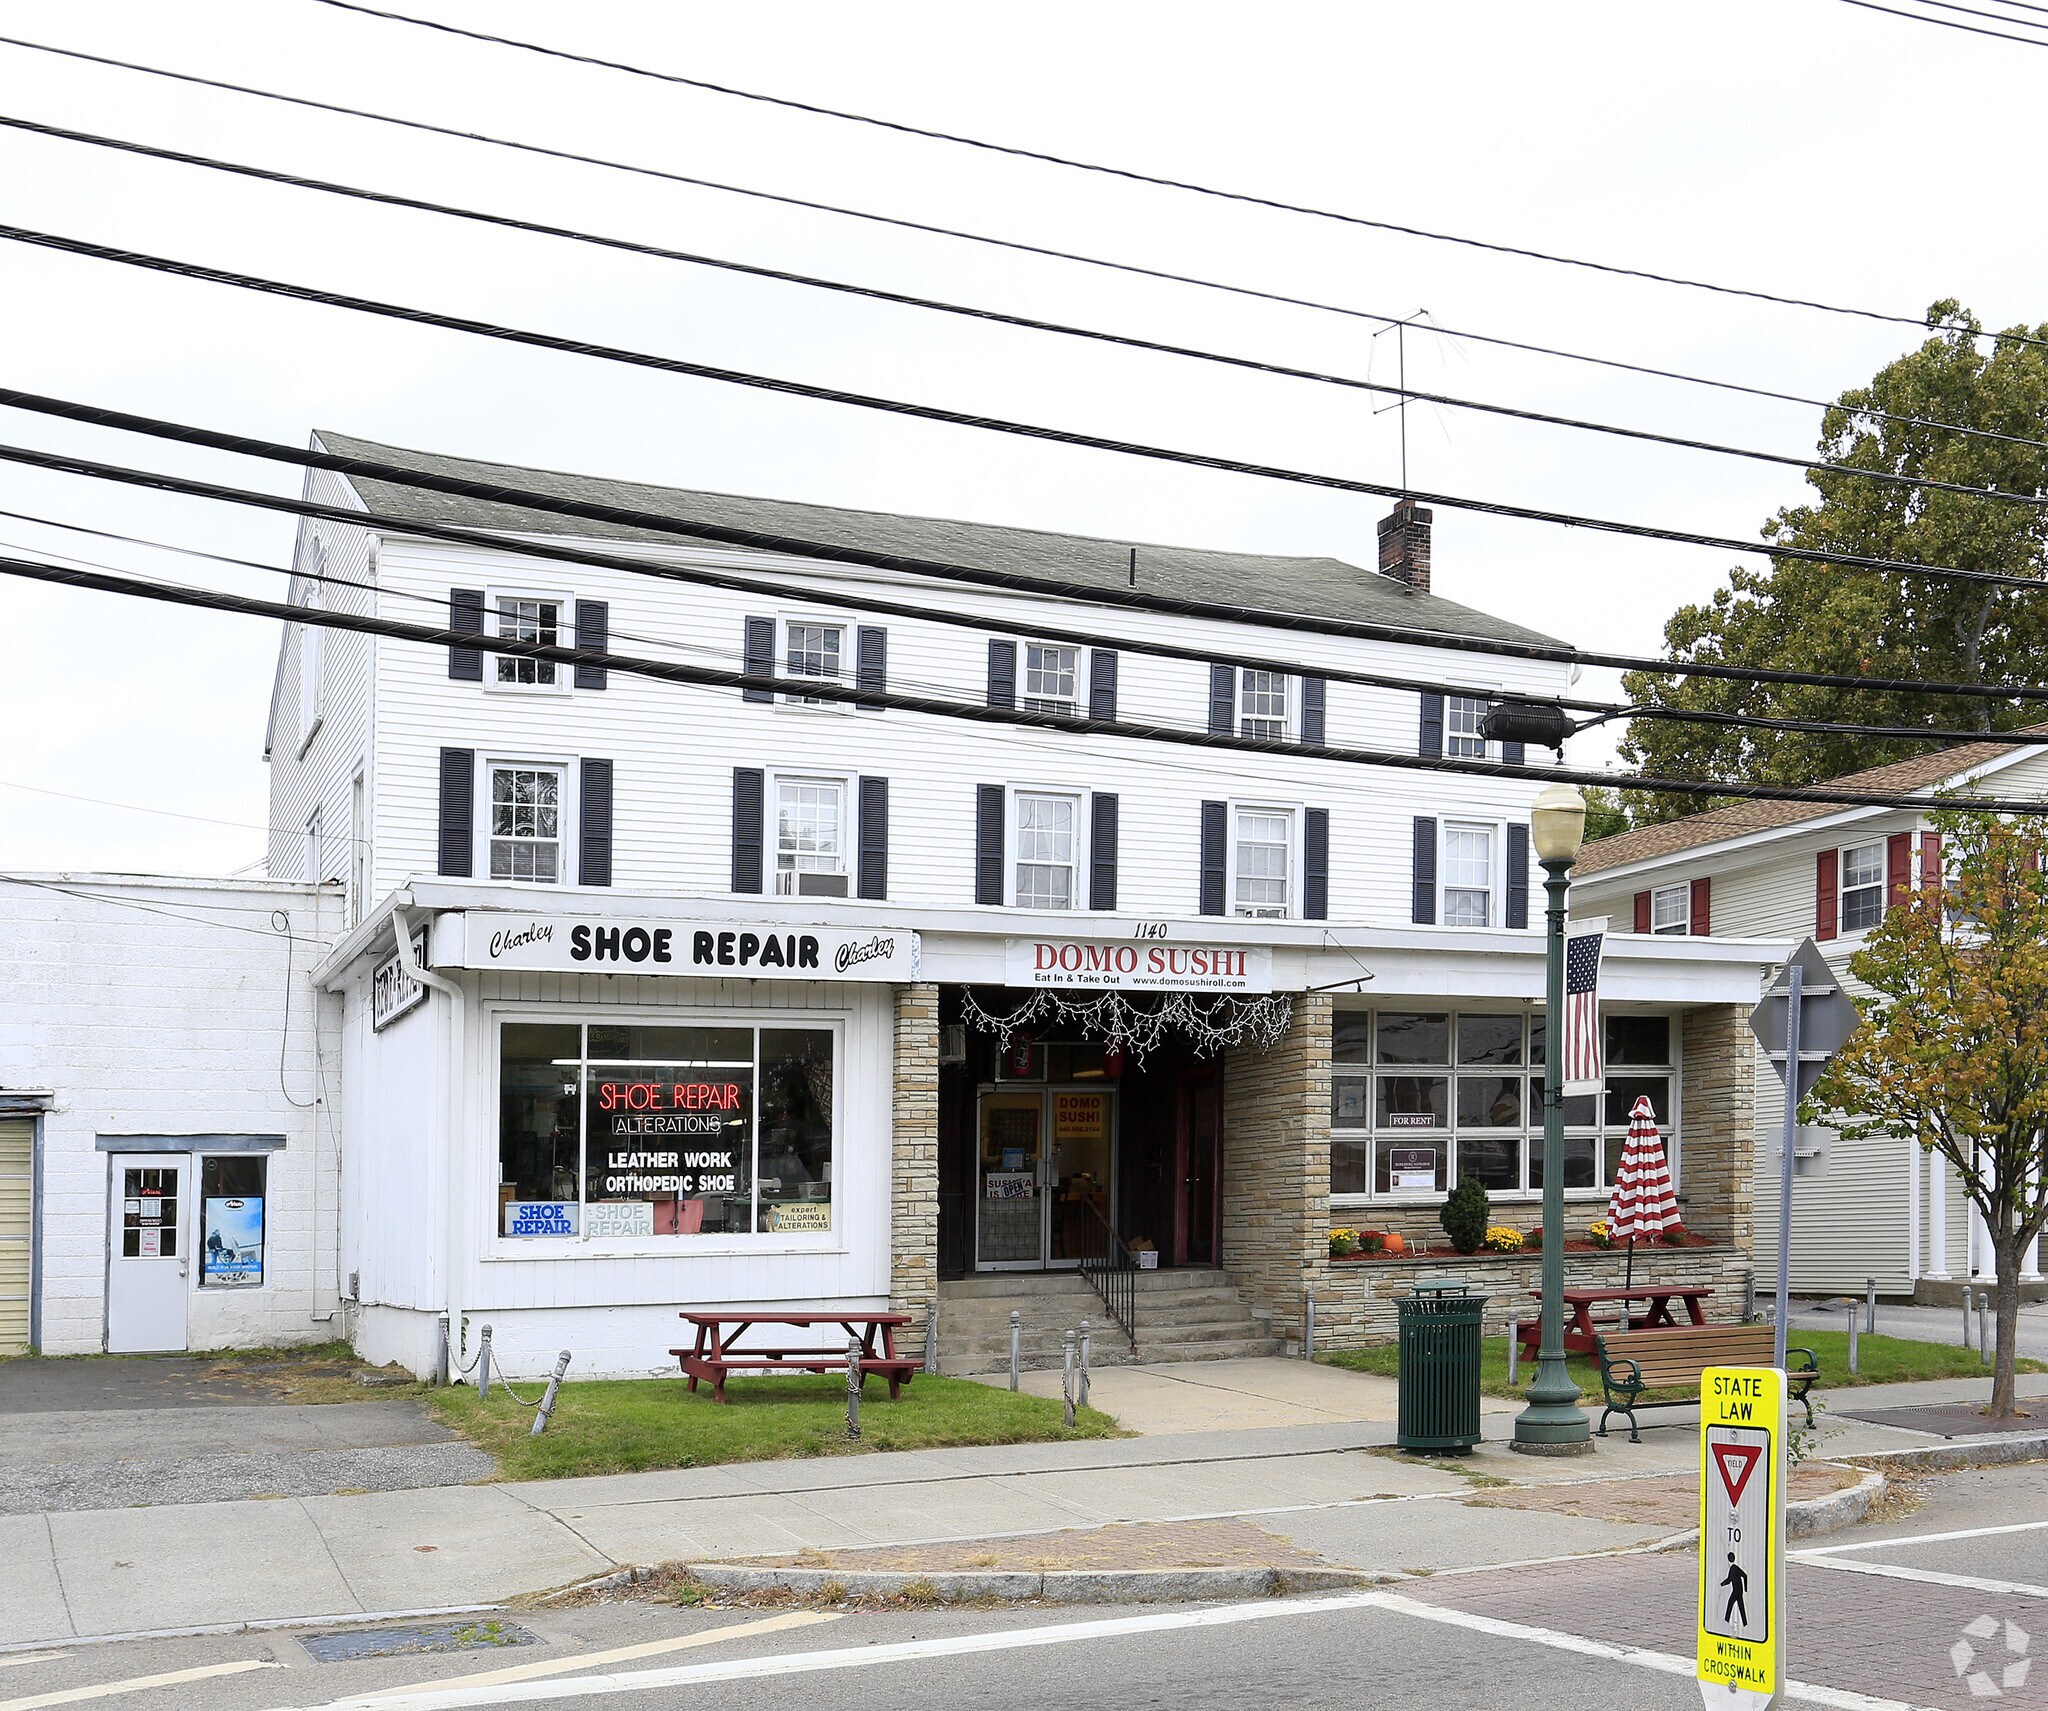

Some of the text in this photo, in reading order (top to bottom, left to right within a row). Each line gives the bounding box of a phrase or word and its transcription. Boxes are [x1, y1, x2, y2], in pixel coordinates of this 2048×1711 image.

[1133, 922, 1168, 939] 1140
[489, 922, 896, 974] Charley SHOE REPAIR Charley
[1033, 943, 1248, 977] DOMO SUSHI
[1034, 973, 1246, 988] Eat In & Take Out www.domosushiroll.com
[600, 1083, 740, 1110] SHOE REPAIR
[1060, 1098, 1100, 1108] DOMO
[616, 1114, 721, 1134] ALTERATIONS
[1060, 1112, 1100, 1122] SUSHI
[1393, 1117, 1431, 1125] FOR RENT
[608, 1151, 732, 1169] LEATHER WORK
[606, 1174, 735, 1192] ORTHOPEDIC SHOE
[1003, 1180, 1024, 1197] OPEN
[518, 1205, 565, 1220] SHOE
[595, 1205, 644, 1220] SHOE
[512, 1219, 572, 1235] REPAIR
[587, 1220, 651, 1235] REPAIR
[1714, 1377, 1763, 1398] STATE
[1720, 1401, 1753, 1421] LAW
[1727, 1459, 1743, 1469] YIELD
[1727, 1527, 1741, 1543] TO
[1716, 1641, 1752, 1661] WITHIN
[1703, 1658, 1766, 1684] CROSSWALK
